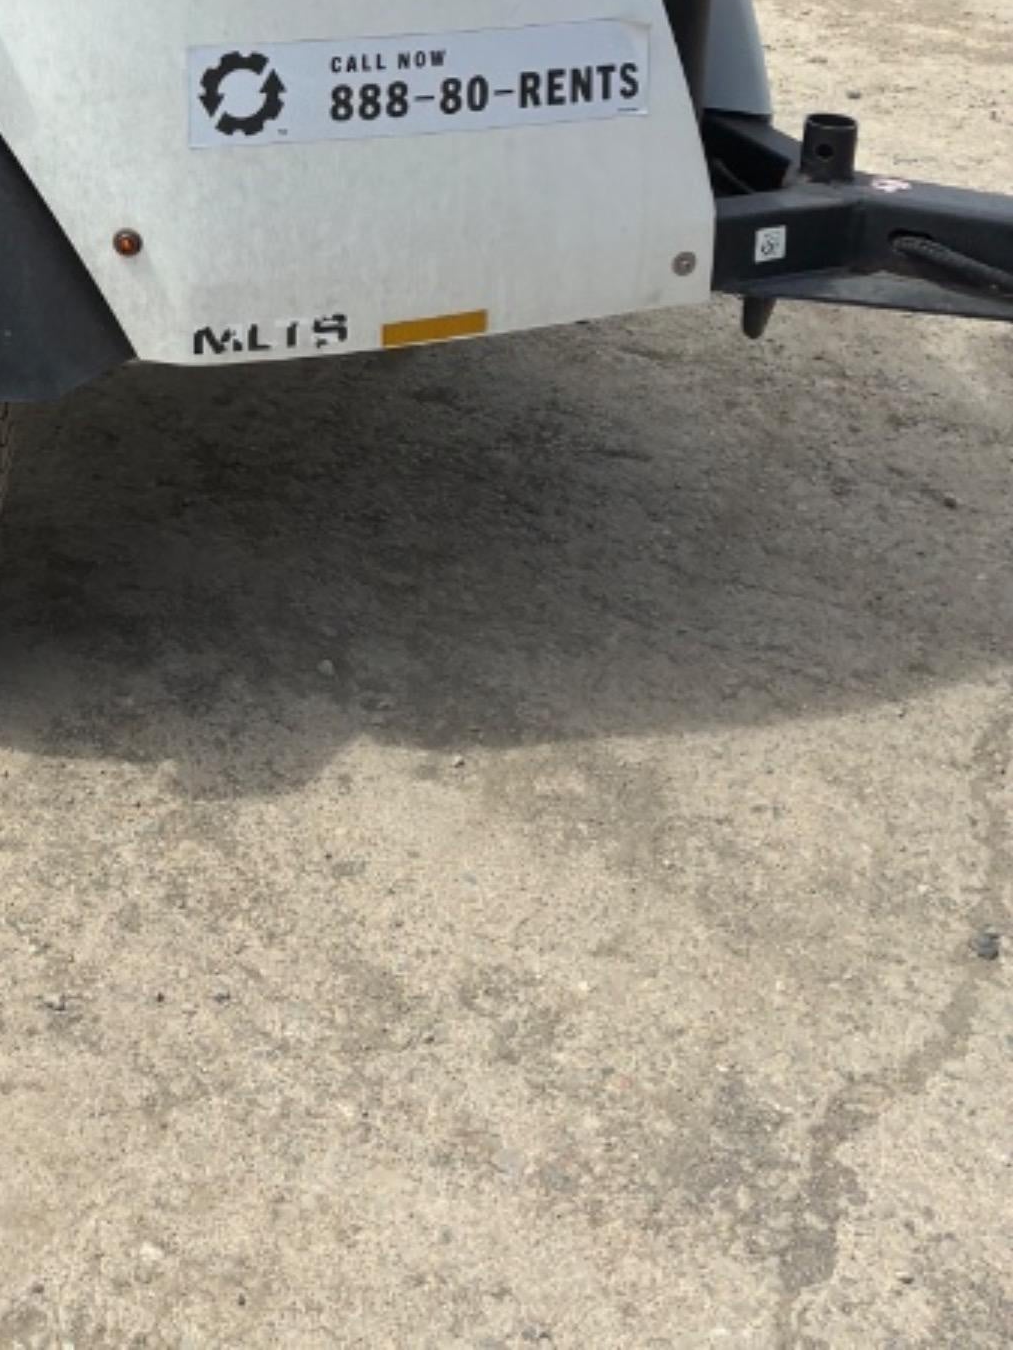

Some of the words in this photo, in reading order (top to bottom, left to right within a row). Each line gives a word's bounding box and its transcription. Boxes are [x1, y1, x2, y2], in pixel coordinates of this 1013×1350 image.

[330, 52, 387, 74] CALL
[396, 48, 448, 70] NOW
[329, 62, 640, 122] 888-80-RENTS
